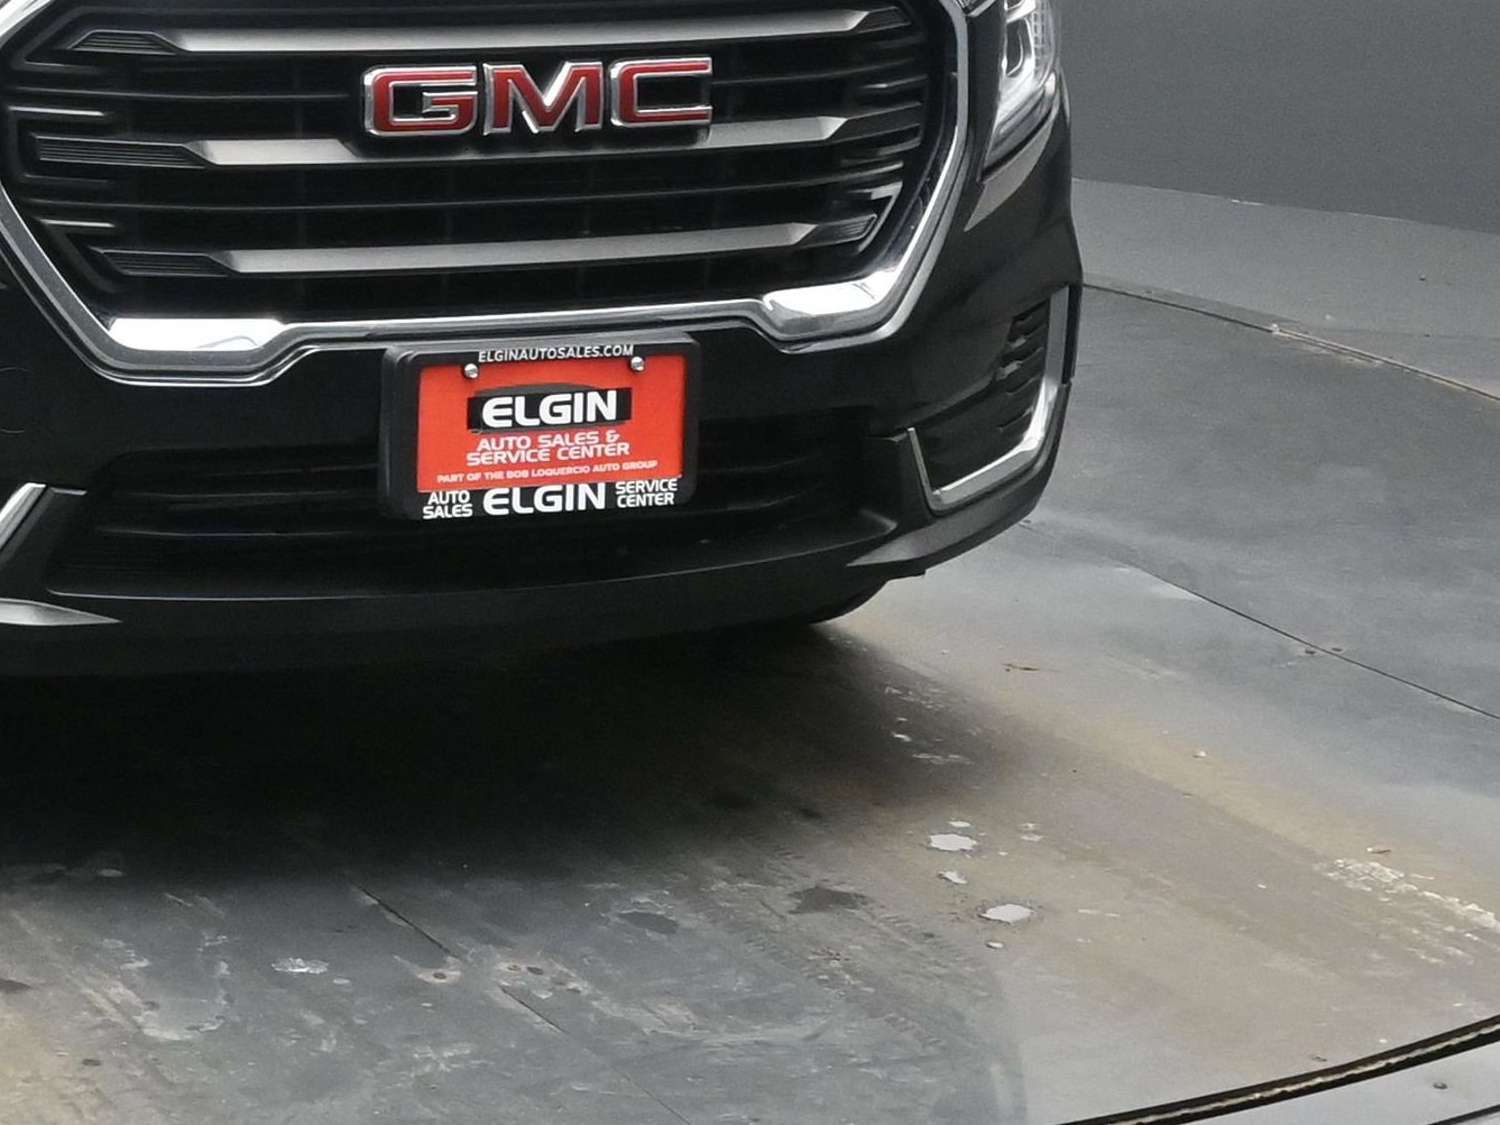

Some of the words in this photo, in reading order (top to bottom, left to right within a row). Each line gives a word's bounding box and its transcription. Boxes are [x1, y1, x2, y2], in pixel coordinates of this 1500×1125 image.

[363, 56, 713, 137] GMC
[477, 345, 634, 363] ELGINAUTOSALES.COM
[481, 389, 617, 428] ELGIN
[476, 435, 531, 452] AUTO
[537, 430, 600, 448] SALES
[606, 429, 620, 443] &
[466, 448, 550, 466] SERVICE
[557, 442, 630, 461] CENTER
[437, 472, 464, 483] PART
[467, 471, 482, 482] OF
[484, 470, 505, 480] THE
[593, 462, 619, 472] AUTO
[622, 460, 658, 471] GROUP
[427, 490, 470, 505] AUTO
[615, 478, 678, 495] SERVICE
[482, 482, 606, 515] ELGIN
[617, 492, 675, 508] CENTER
[422, 503, 473, 520] SALES
